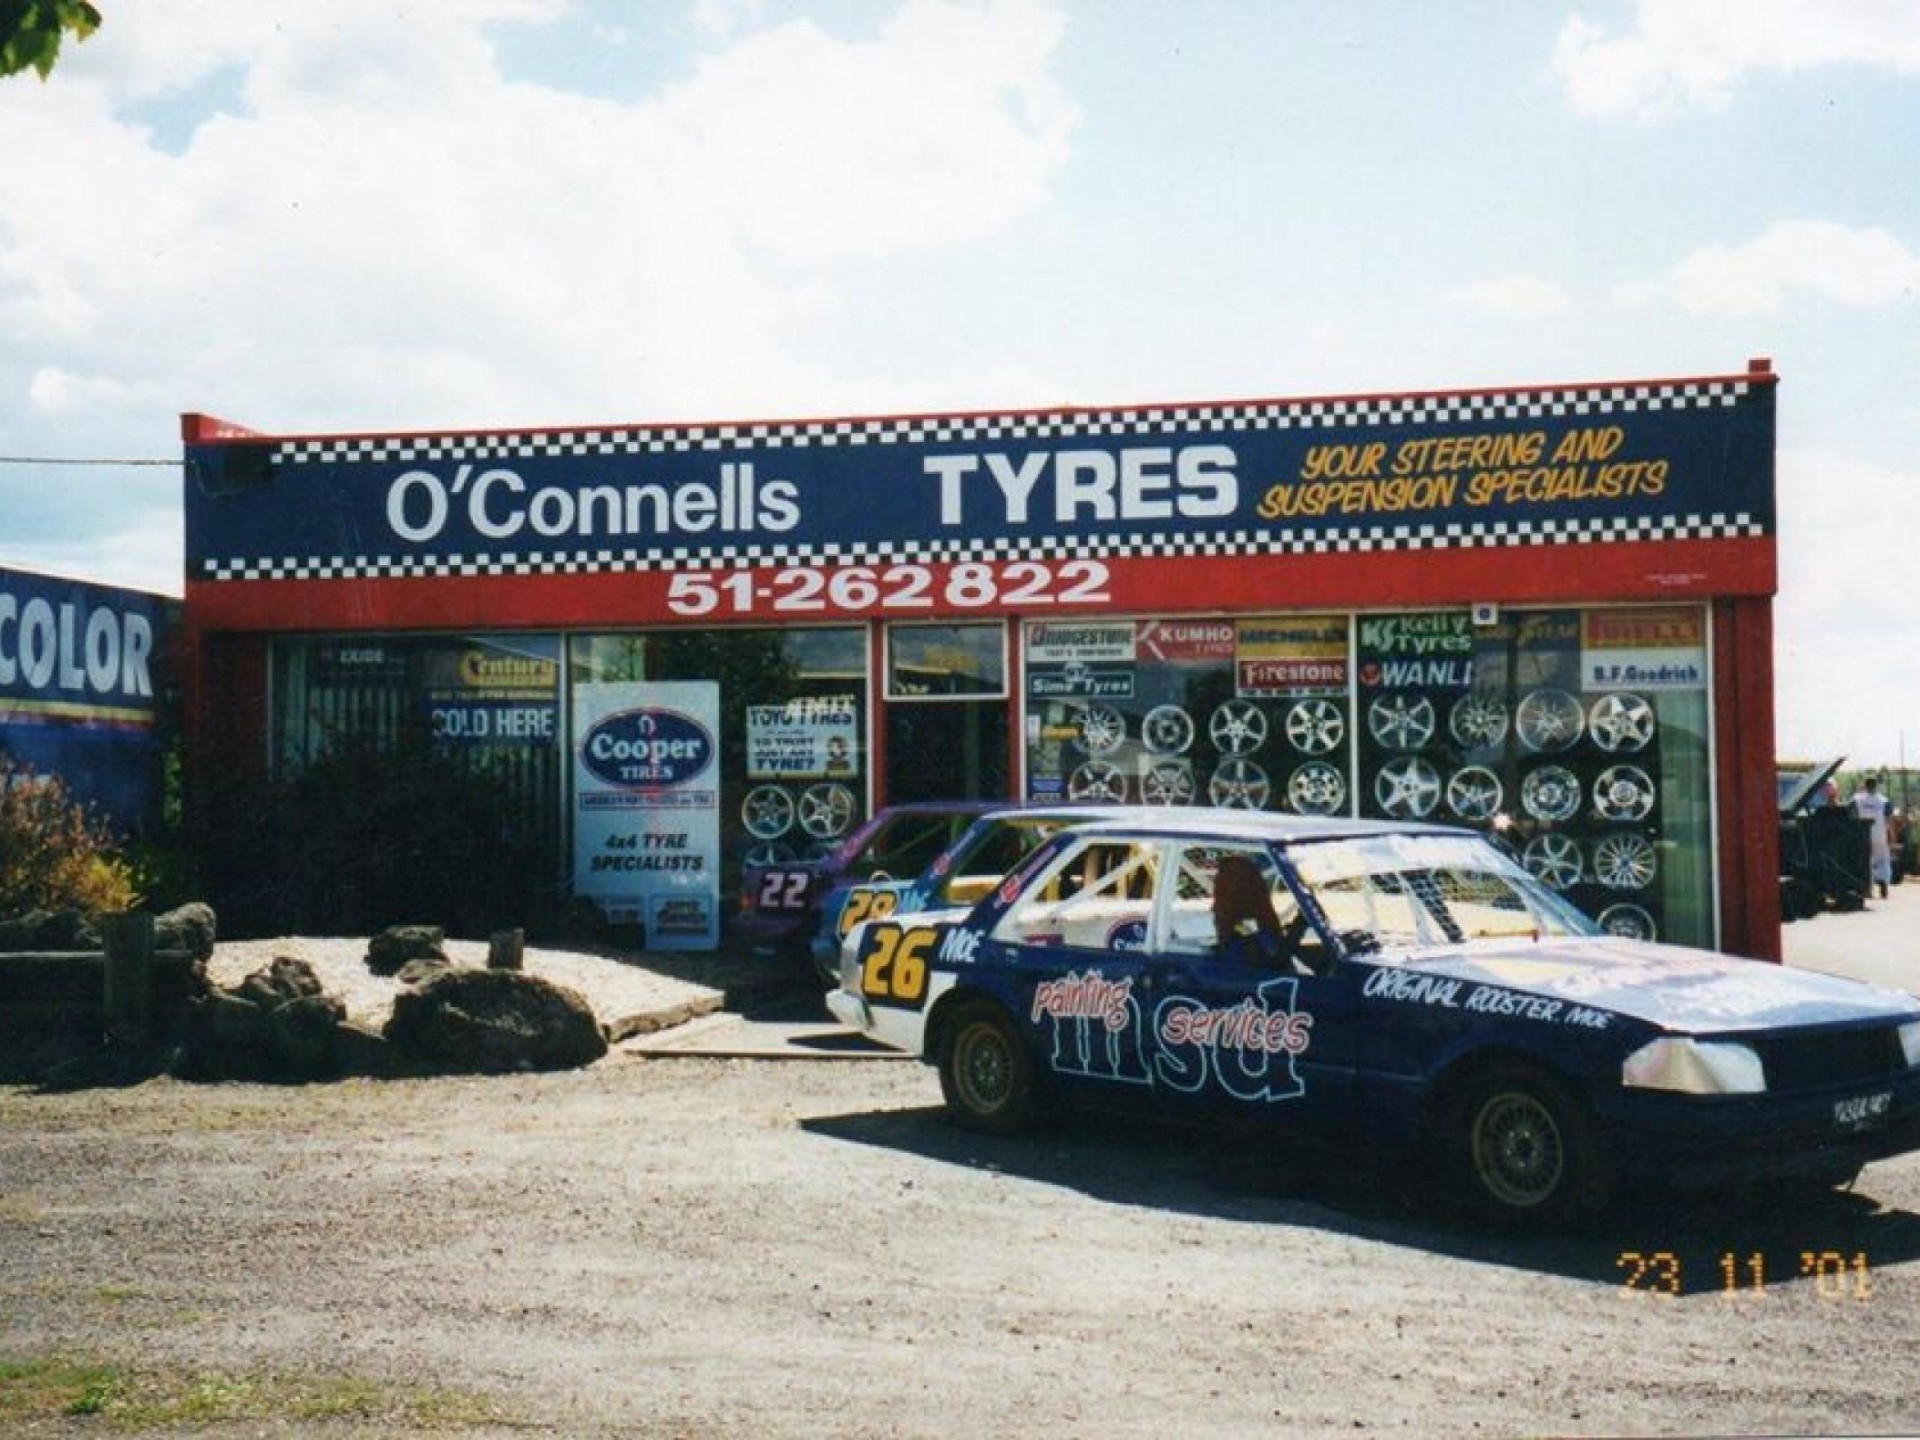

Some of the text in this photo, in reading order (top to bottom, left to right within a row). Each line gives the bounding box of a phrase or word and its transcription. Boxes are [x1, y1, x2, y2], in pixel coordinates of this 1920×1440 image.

[1301, 426, 1625, 479] YOUR STEERING AND
[386, 445, 1238, 542] O'Connells TYRES
[1256, 460, 1669, 519] SUSPENSION SPECIALISTS
[1160, 626, 1234, 643] KUMHO
[1401, 612, 1469, 634] Kelly
[0, 592, 153, 697] COLOR
[1395, 634, 1472, 655] Tyres
[1083, 678, 1130, 695] Tyres
[1242, 664, 1344, 685] Firestone
[1383, 660, 1472, 687] WANLI
[497, 707, 554, 736] HERE
[591, 732, 702, 765] Cooper
[605, 832, 688, 849] 4x4 TYRE
[590, 855, 704, 872] SPECIALISTS
[759, 871, 809, 908] 22
[863, 926, 985, 1000] 26 MOE
[1031, 969, 1134, 1031] painting
[1362, 966, 1464, 1008] ORIGINAL
[1161, 998, 1314, 1053] services
